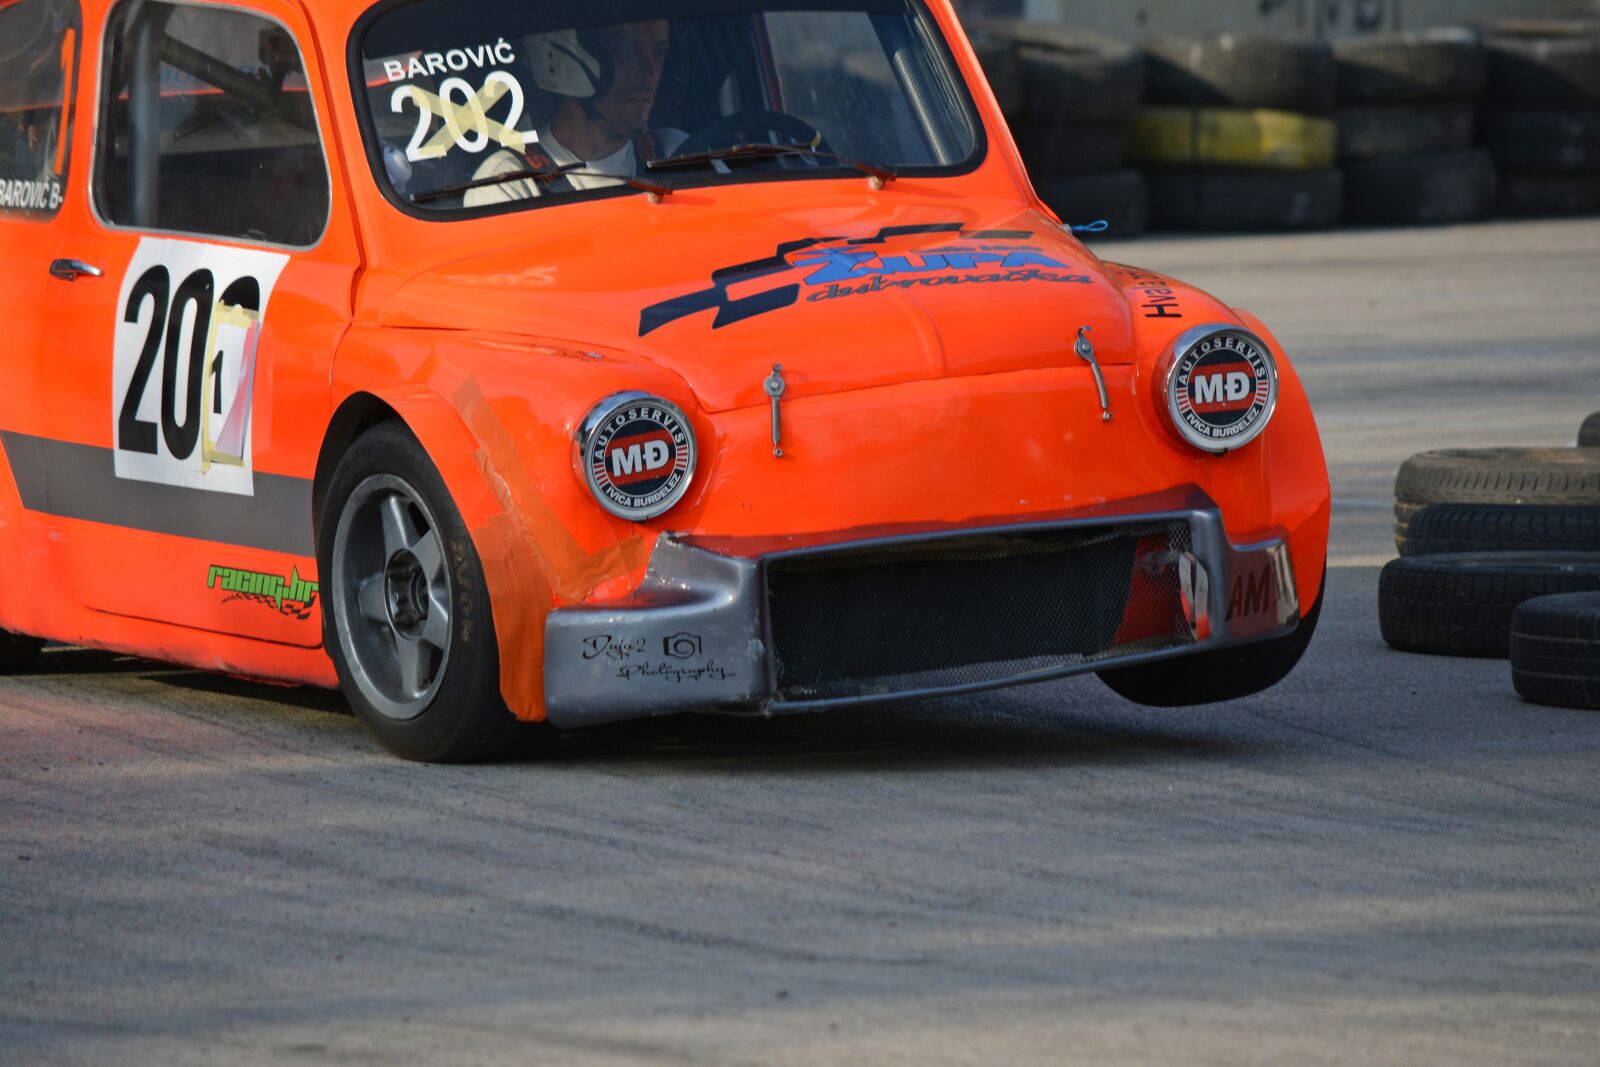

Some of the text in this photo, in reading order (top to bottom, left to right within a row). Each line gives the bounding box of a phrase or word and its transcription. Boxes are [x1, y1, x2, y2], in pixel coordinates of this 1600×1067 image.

[383, 37, 516, 82] BAROVIĆ
[390, 70, 540, 162] 202
[1178, 337, 1266, 386] AUTOSERVIS
[594, 407, 685, 460] AUTOSERVIS
[1186, 406, 1260, 438] IVICA BURDELEZ
[605, 472, 681, 507] IVICA BURDELEZ
[616, 659, 736, 683] Photography
